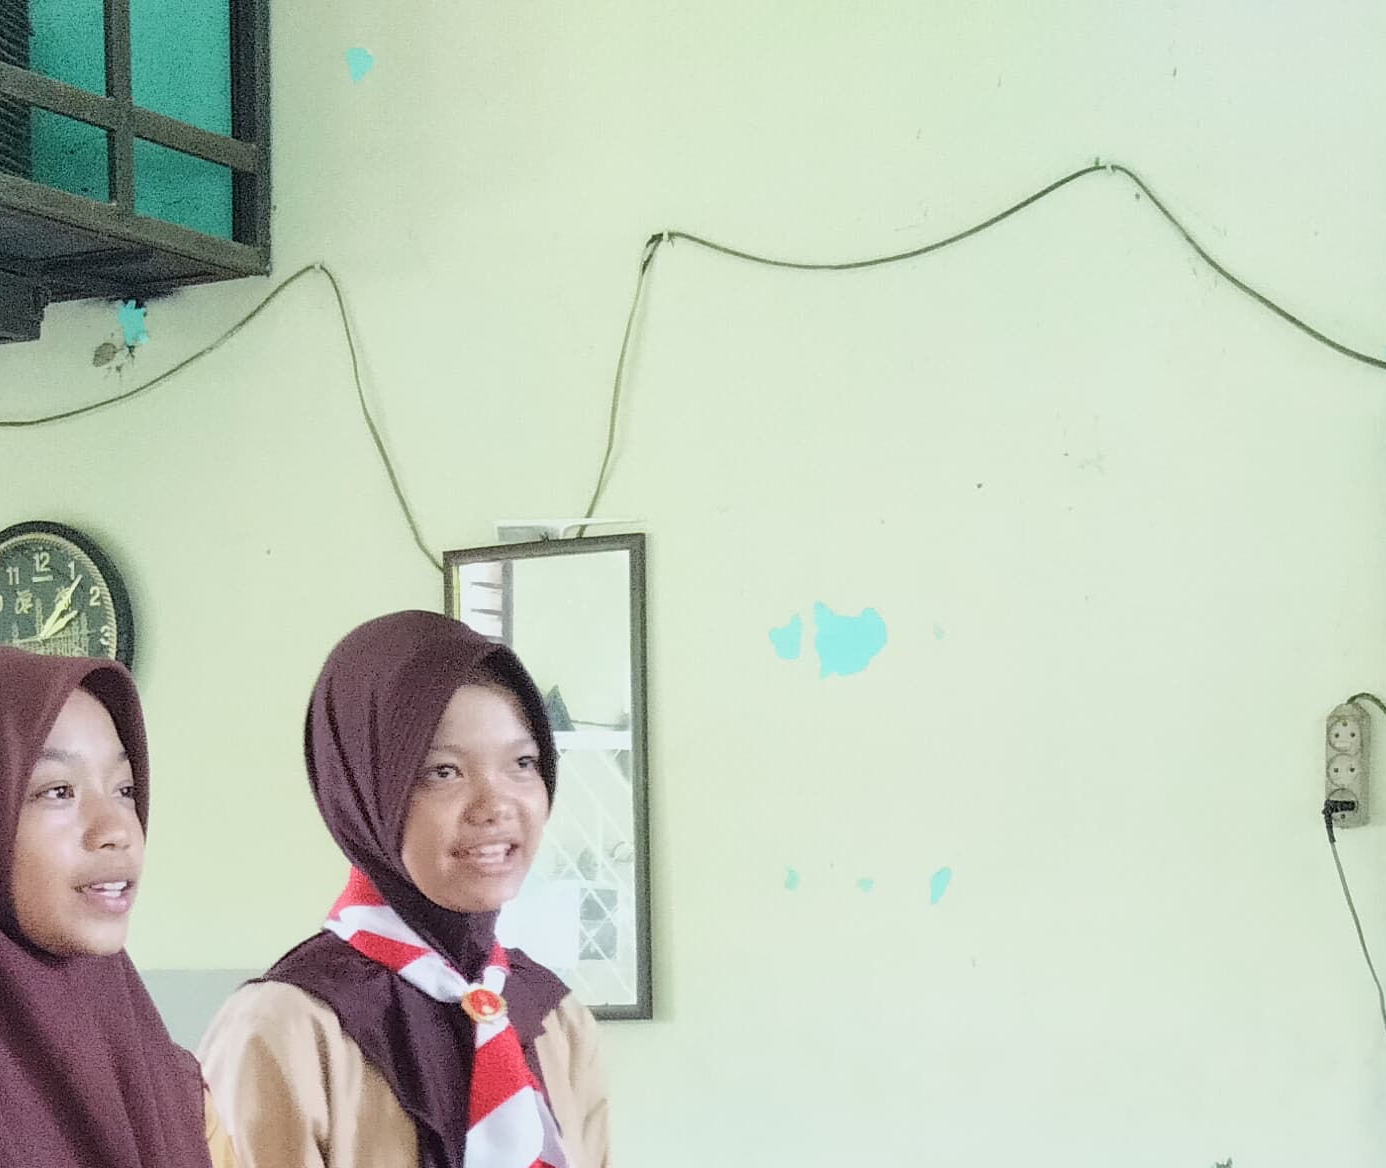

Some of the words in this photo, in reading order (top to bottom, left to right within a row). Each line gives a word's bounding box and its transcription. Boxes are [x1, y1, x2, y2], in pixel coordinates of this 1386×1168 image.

[33, 552, 51, 572] 12
[6, 567, 20, 586] 11
[89, 586, 101, 607] 2
